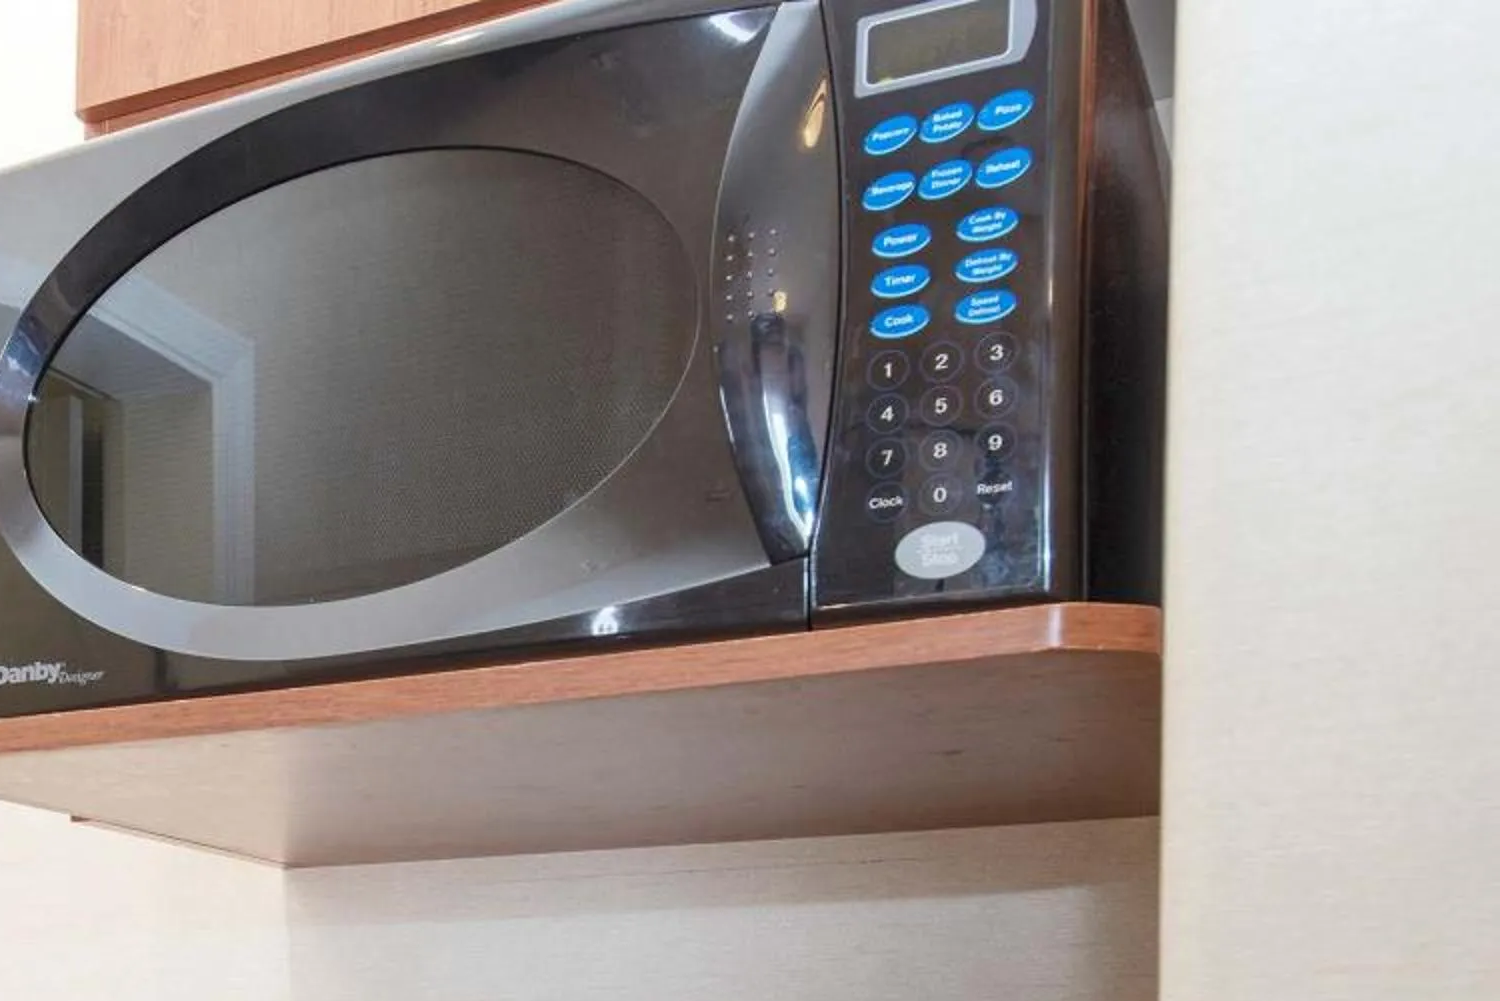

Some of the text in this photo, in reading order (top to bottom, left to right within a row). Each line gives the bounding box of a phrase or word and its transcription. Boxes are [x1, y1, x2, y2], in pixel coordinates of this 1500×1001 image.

[883, 233, 918, 248] Power
[884, 274, 916, 287] Timer
[884, 313, 914, 328] Cook
[989, 344, 1004, 361] 3
[934, 353, 949, 371] 2
[883, 363, 893, 378] 1
[989, 389, 1003, 405] 6
[880, 405, 894, 422] 4
[934, 397, 948, 414] 5
[933, 441, 947, 459] 8
[988, 434, 1002, 450] 9
[881, 449, 893, 466] 7
[932, 487, 947, 503] 0
[976, 480, 1013, 496] Reset
[869, 496, 904, 509] Clock
